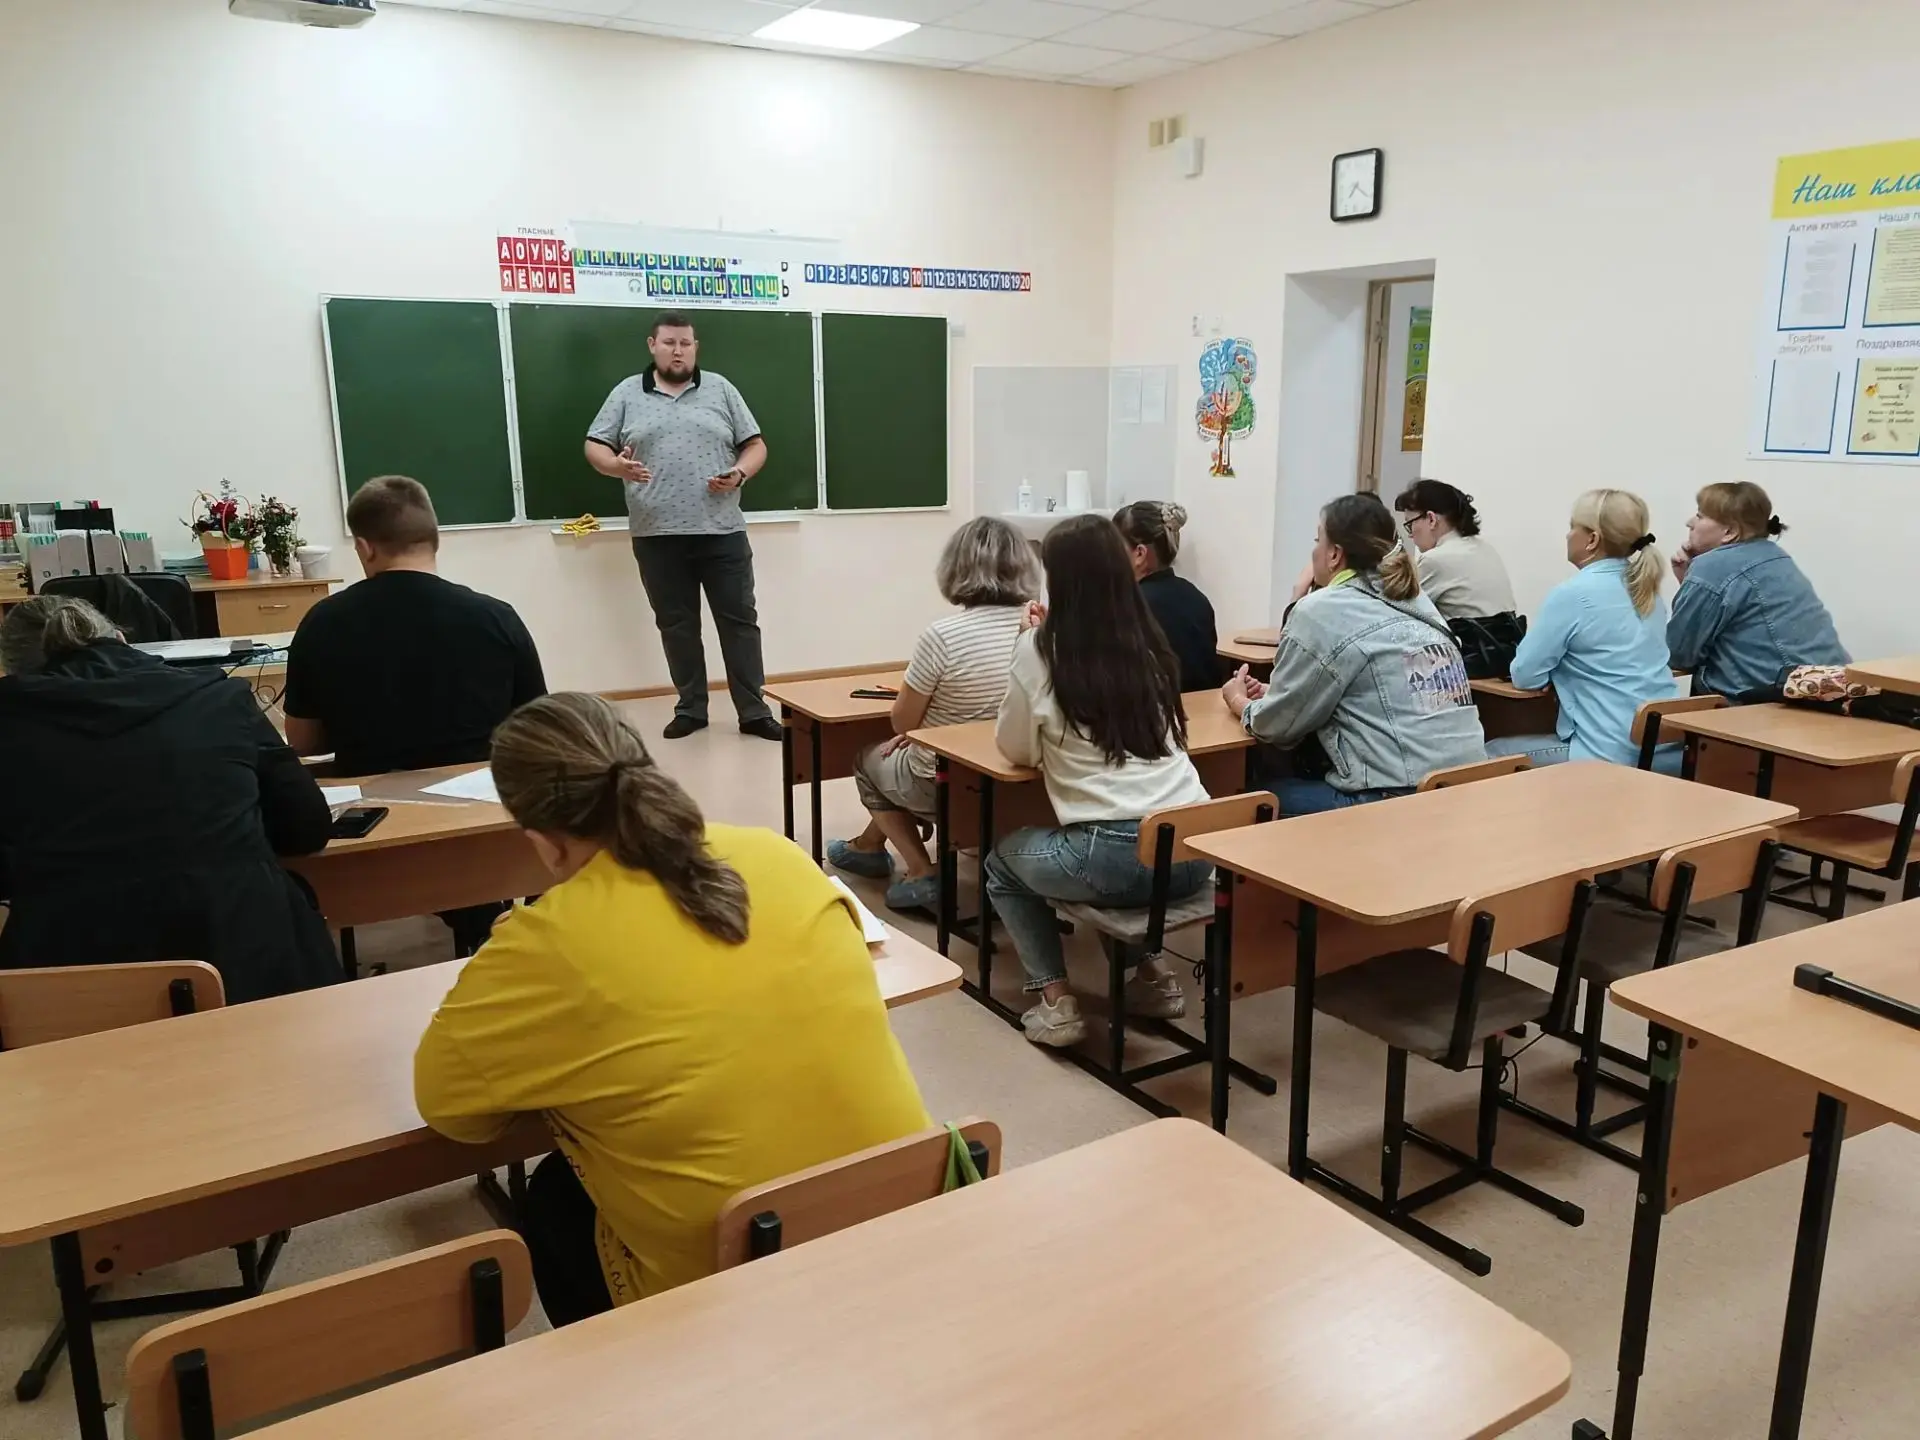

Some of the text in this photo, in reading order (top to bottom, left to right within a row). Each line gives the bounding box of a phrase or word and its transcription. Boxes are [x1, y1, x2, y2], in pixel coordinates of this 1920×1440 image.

[1792, 174, 1857, 204] Наш
[1820, 219, 1858, 230] класса
[517, 227, 555, 236] ГЛАСНЫЕ
